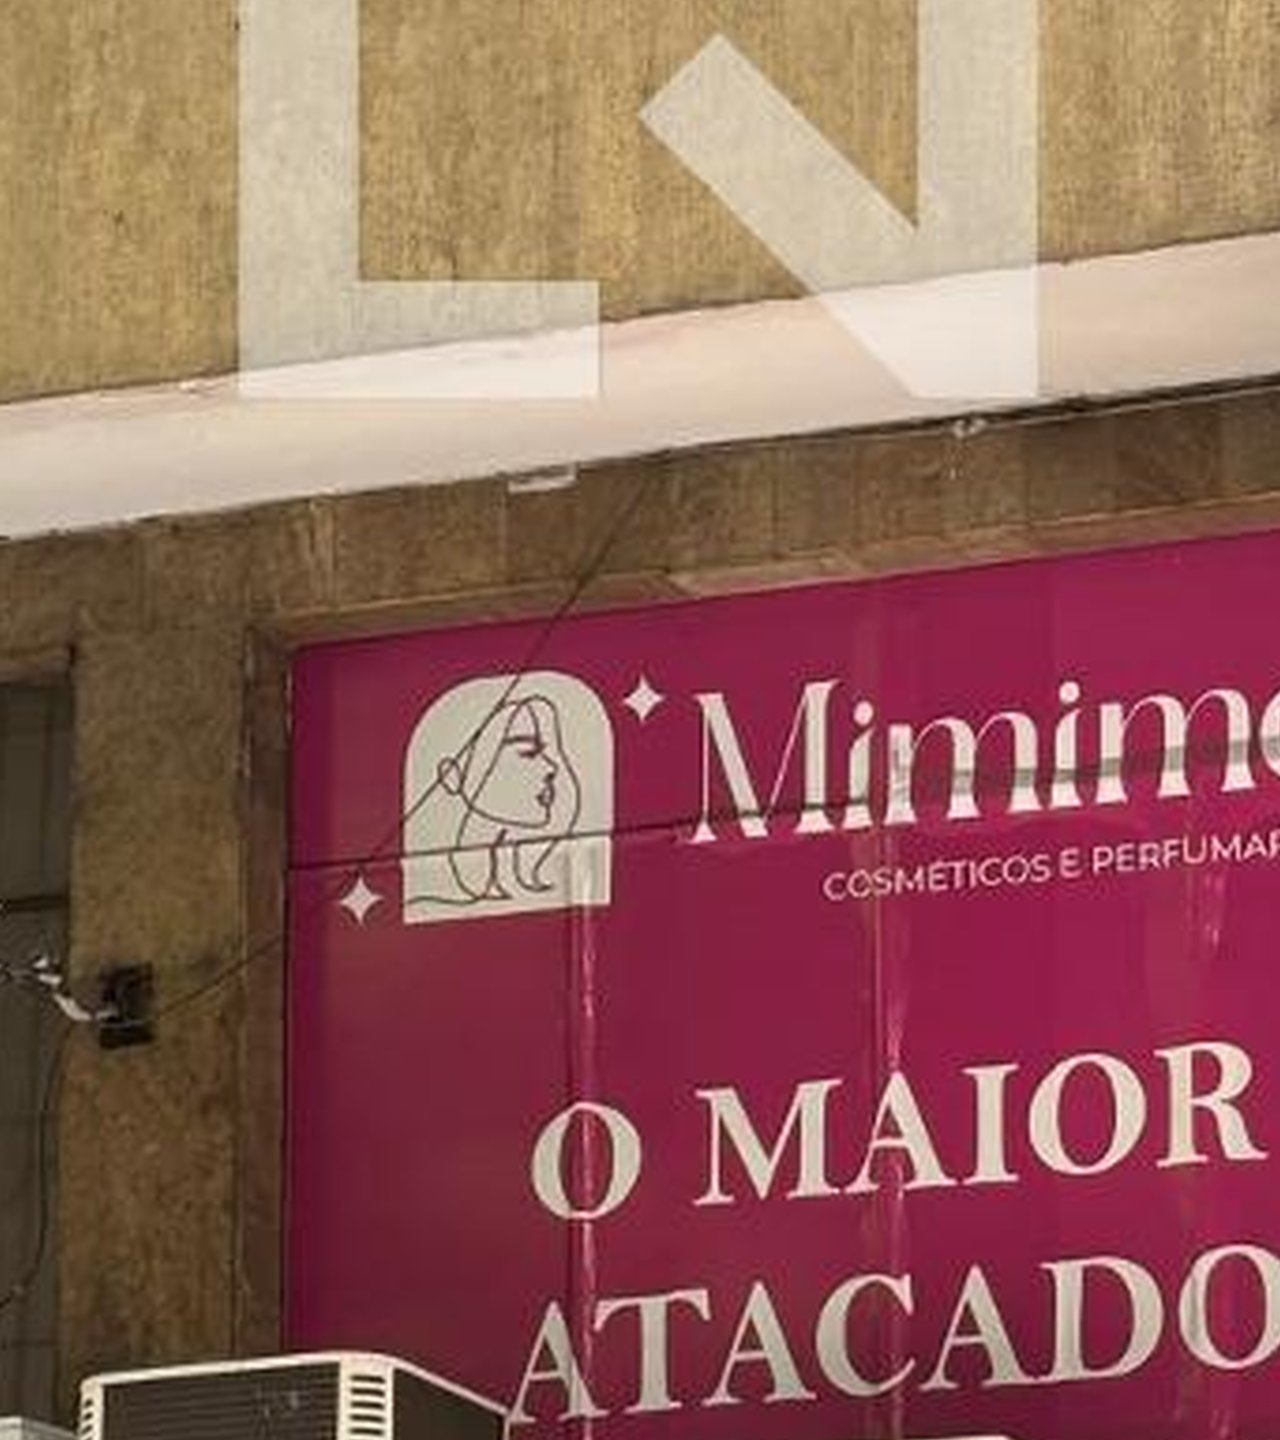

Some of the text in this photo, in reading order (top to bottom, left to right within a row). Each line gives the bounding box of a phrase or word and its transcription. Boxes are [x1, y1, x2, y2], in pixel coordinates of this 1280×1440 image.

[1059, 848, 1082, 880] E
[529, 1040, 1269, 1221] O MAIOR
